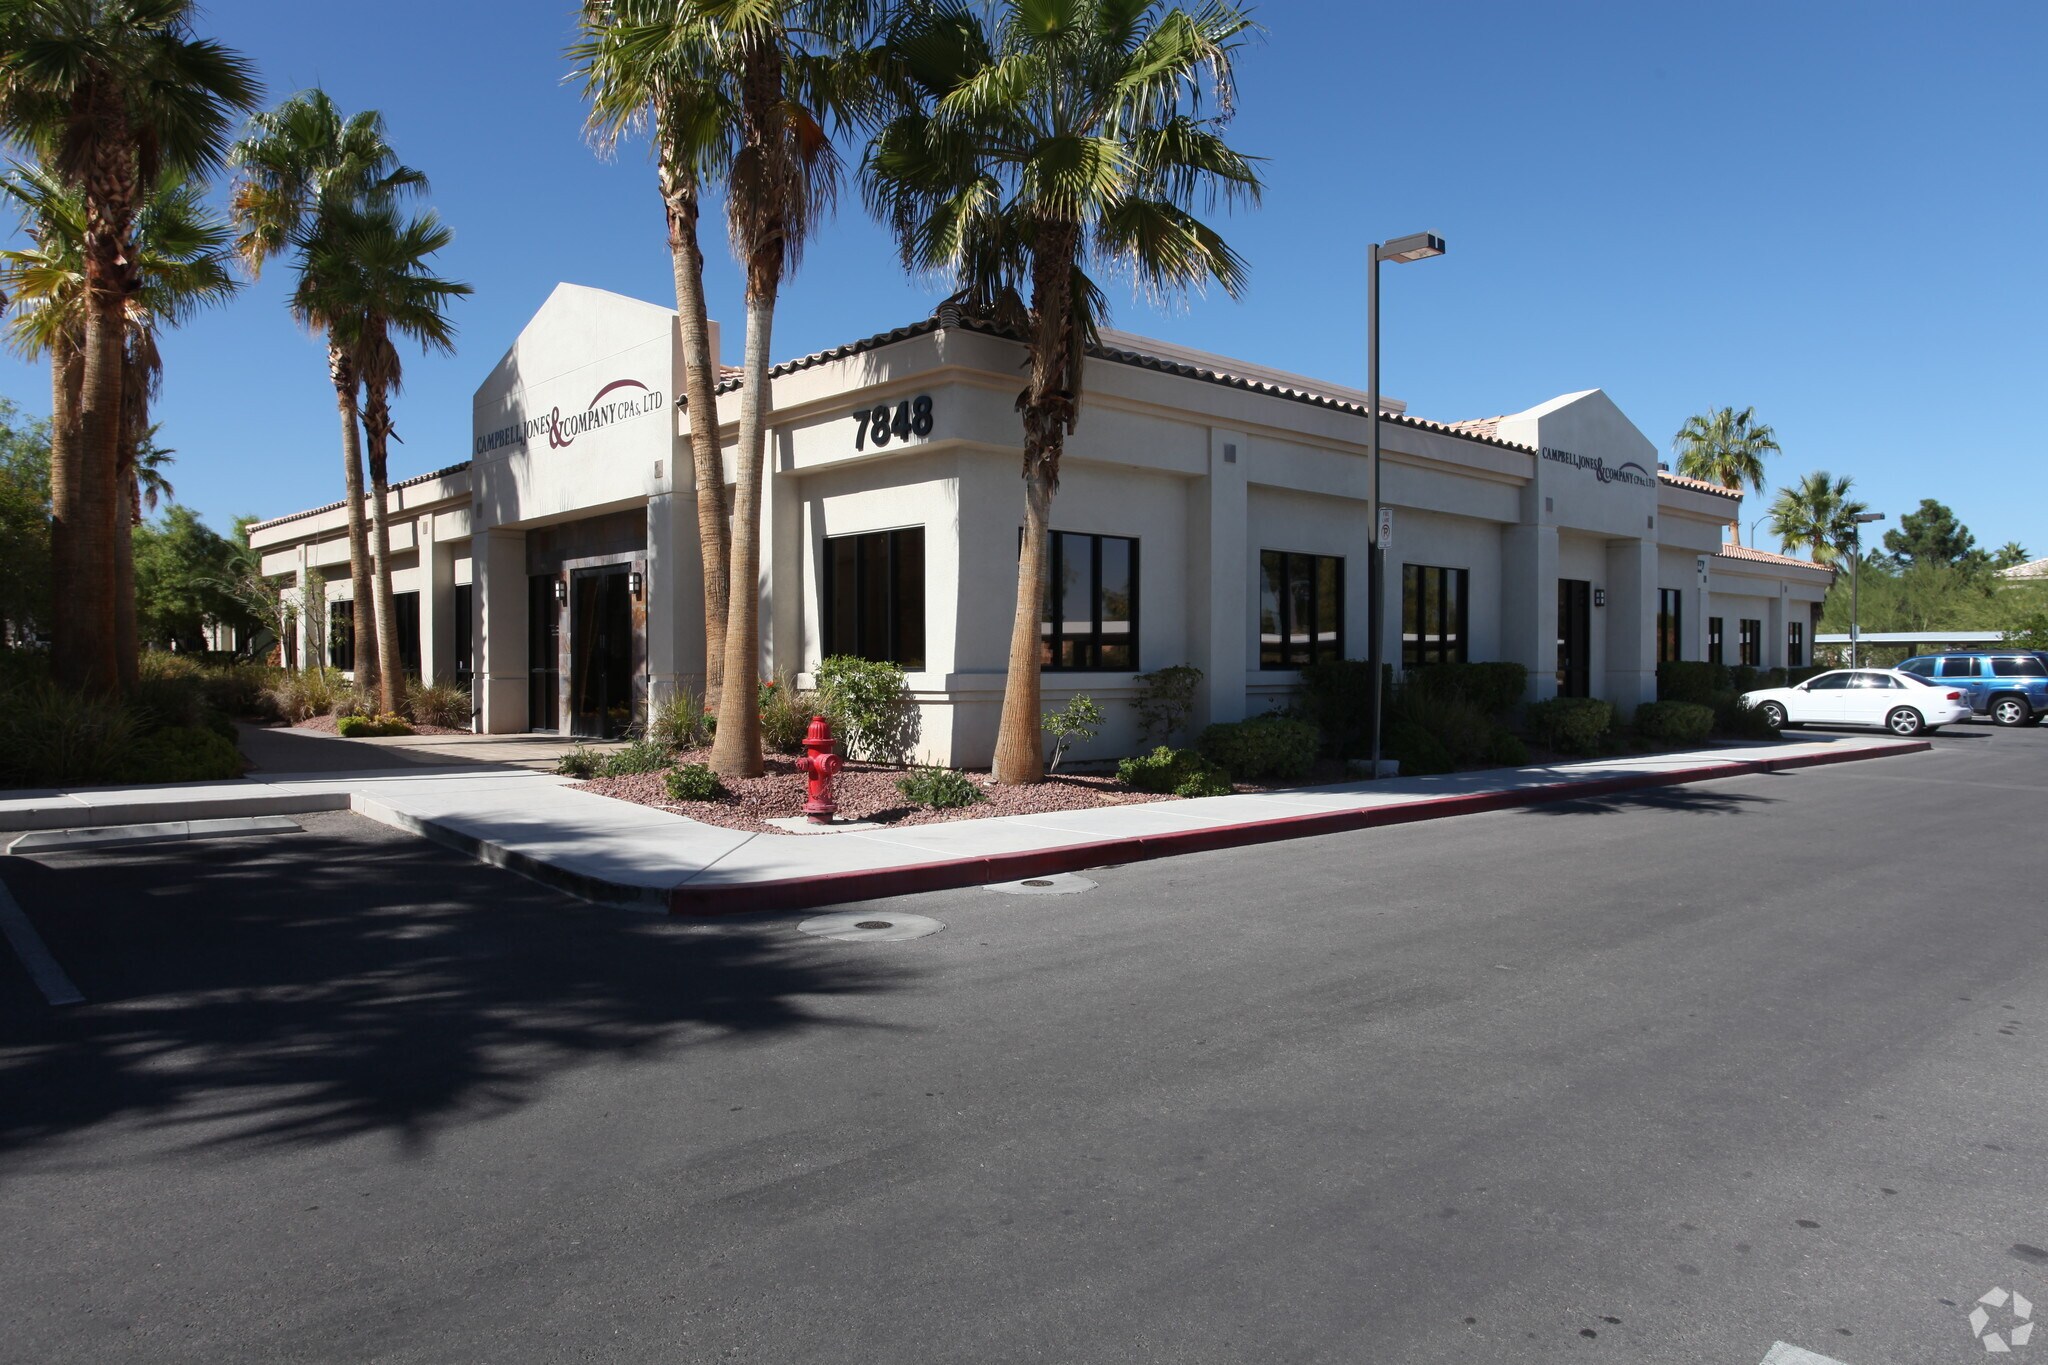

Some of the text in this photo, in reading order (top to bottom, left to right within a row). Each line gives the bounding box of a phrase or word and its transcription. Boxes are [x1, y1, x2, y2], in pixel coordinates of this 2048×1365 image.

[477, 424, 524, 454] CAMPBELL,
[523, 413, 550, 447] JONES
[549, 406, 575, 450] &
[564, 402, 617, 437] COMPANY
[643, 391, 663, 413] LTD
[853, 395, 933, 452] 7848
